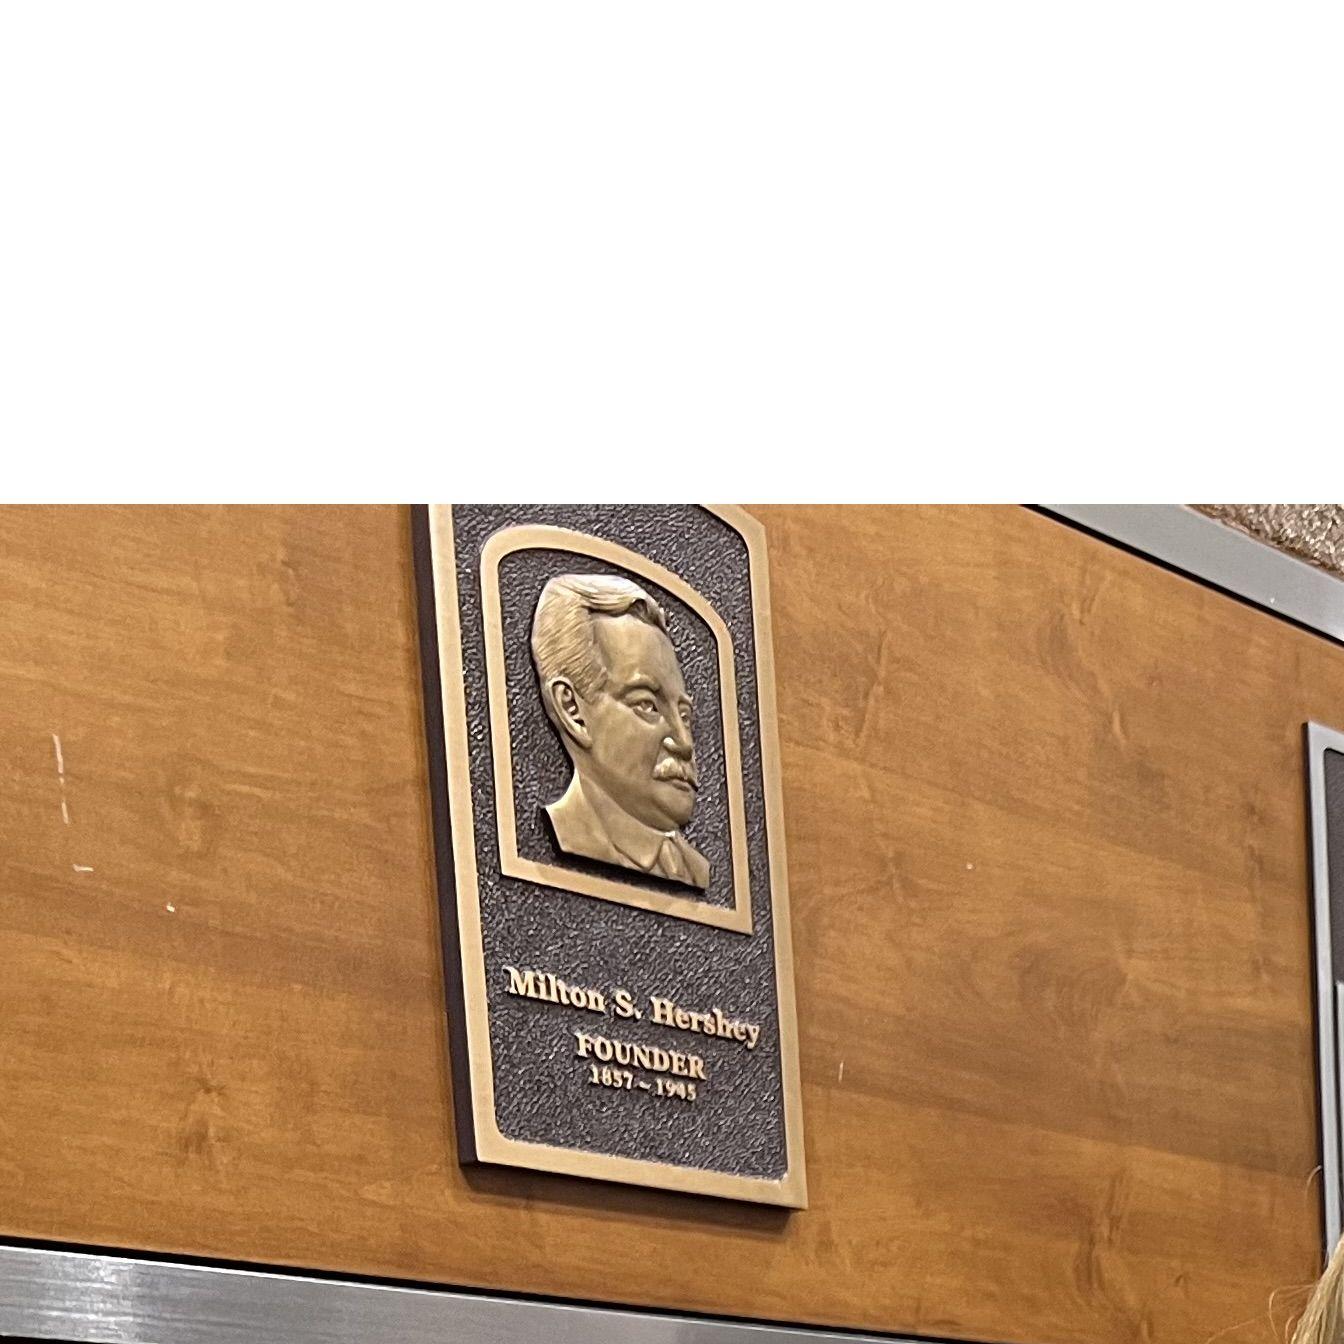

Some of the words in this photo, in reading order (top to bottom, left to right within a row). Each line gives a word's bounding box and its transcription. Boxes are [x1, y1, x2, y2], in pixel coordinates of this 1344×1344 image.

[503, 965, 605, 1013] Milton
[615, 989, 643, 1020] S.
[650, 996, 761, 1049] Hershey
[574, 1032, 707, 1080] FOUNDER
[590, 1067, 634, 1090] 1857
[656, 1077, 698, 1102] 1945
